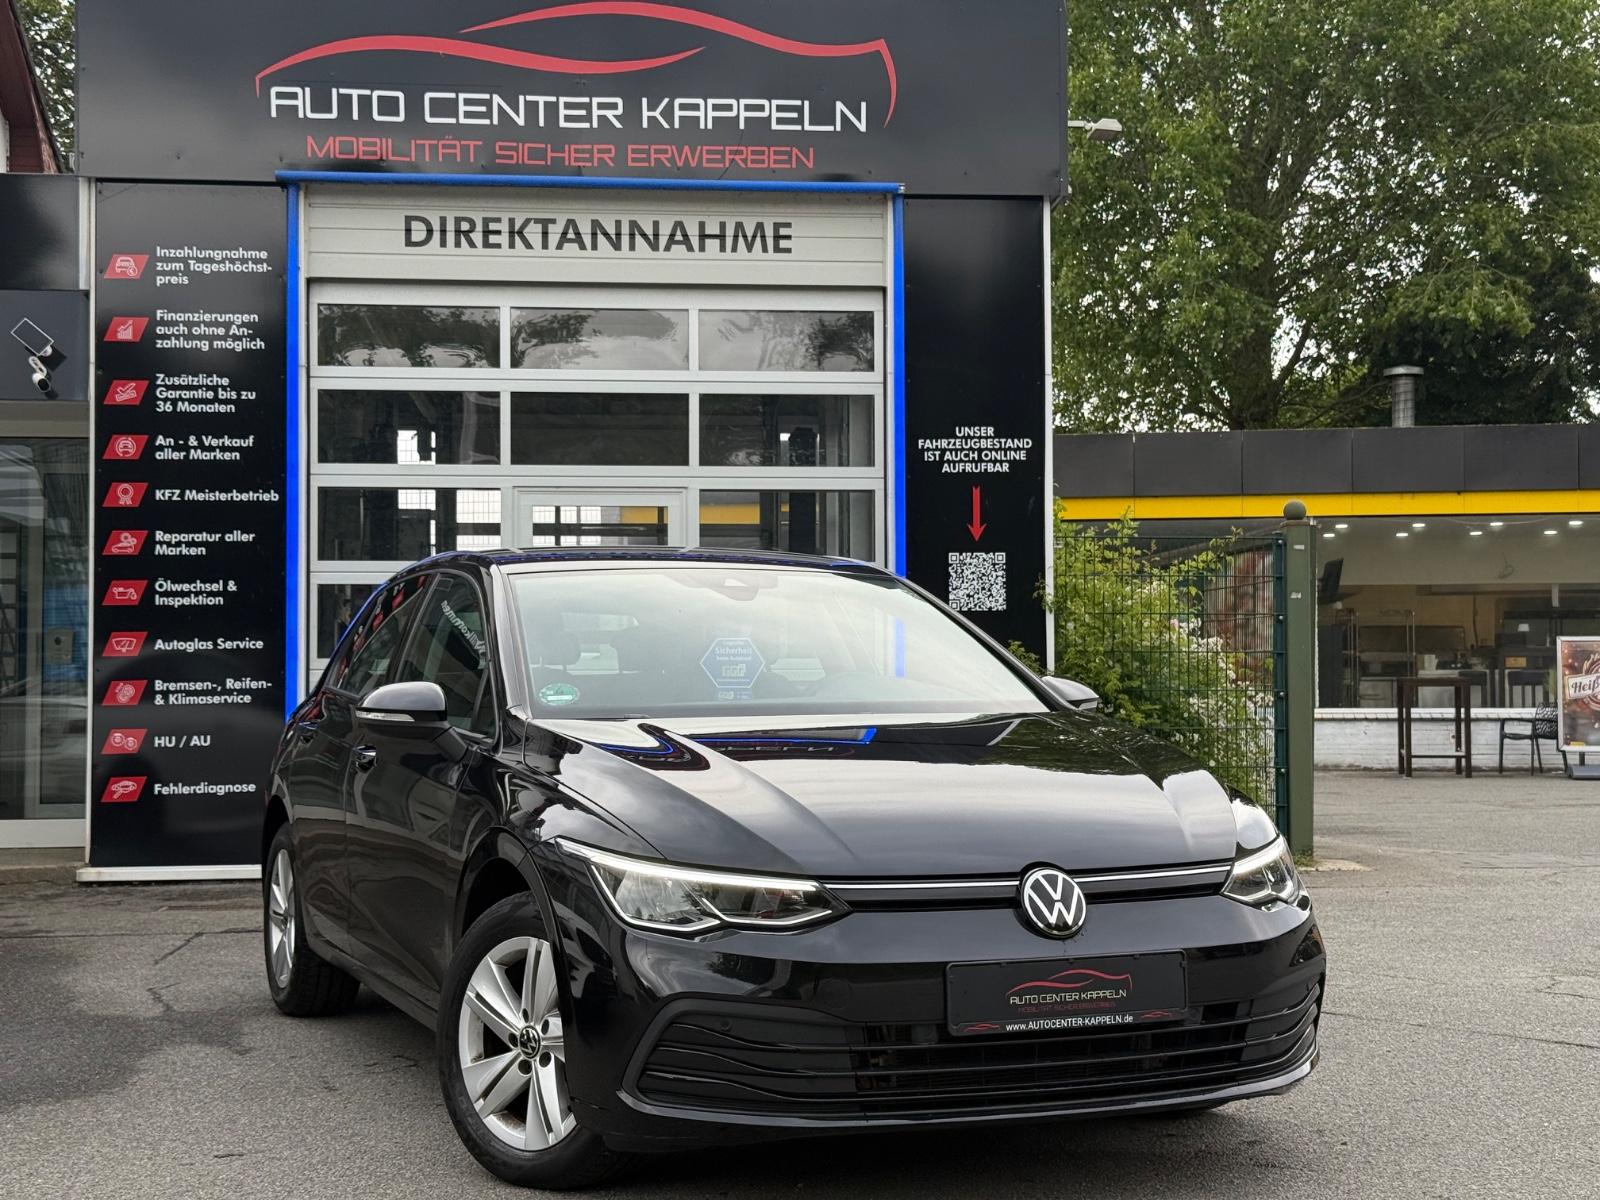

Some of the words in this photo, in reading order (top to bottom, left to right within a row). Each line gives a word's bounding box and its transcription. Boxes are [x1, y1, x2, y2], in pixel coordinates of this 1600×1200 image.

[270, 86, 405, 122] AUTO
[424, 92, 623, 129] CENTER
[642, 97, 866, 132] KAPPELN
[307, 136, 482, 162] MOBILITÄT
[495, 141, 616, 168] SICHER
[627, 144, 814, 168] ERWERBEN
[404, 215, 793, 255] DIREKTANNAHME
[156, 246, 268, 260] Inzahlungnahme
[156, 261, 185, 272] zum
[188, 260, 272, 273] Tageshöchst-
[156, 274, 189, 287] preis
[157, 310, 258, 324] Finanzierungen
[156, 324, 188, 335] auch
[192, 325, 225, 335] ohne
[229, 325, 253, 335] An-
[156, 338, 209, 351] zahlung
[213, 338, 265, 351] möglich
[156, 374, 229, 386] Zusätzliche
[156, 387, 214, 400] Garantie
[218, 388, 237, 400] bis
[240, 390, 256, 400] zu
[156, 402, 173, 413] 36
[177, 402, 235, 413] Monaten
[955, 427, 994, 437] UNSER
[155, 436, 174, 446] An
[189, 436, 199, 446] &
[202, 436, 254, 447] Verkauf
[918, 438, 1032, 449] FAHRZEUGBESTAND
[155, 449, 186, 460] aller
[190, 450, 240, 460] Marken
[924, 451, 941, 461] IST
[944, 451, 978, 461] AUCH
[981, 450, 1026, 461] ONLINE
[942, 462, 1009, 473] AUFRUFBAR
[155, 490, 181, 500] KFZ
[185, 490, 279, 501] Meisterbetrieb
[155, 531, 222, 544] Reparatur
[224, 531, 255, 542] aller
[154, 544, 206, 556] Marken
[155, 578, 224, 592] Ölwechsel
[227, 580, 237, 592] &
[155, 594, 224, 608] Inspektion
[154, 638, 213, 652] Autoglas
[217, 638, 264, 650] Service
[154, 679, 222, 692] Bremsen-,
[226, 678, 272, 690] Reifen-
[154, 694, 165, 706] &
[169, 692, 252, 705] Klimaservice
[154, 736, 176, 748] HU
[190, 735, 210, 747] AU
[154, 782, 256, 796] Fehlerdiagnose
[1010, 995, 1038, 1004] AUTO
[1040, 992, 1079, 1003] CENTER
[1081, 989, 1127, 999] KAPPELN
[1006, 1014, 1133, 1031] www.AUTOCENTER-KAPPELN.de
